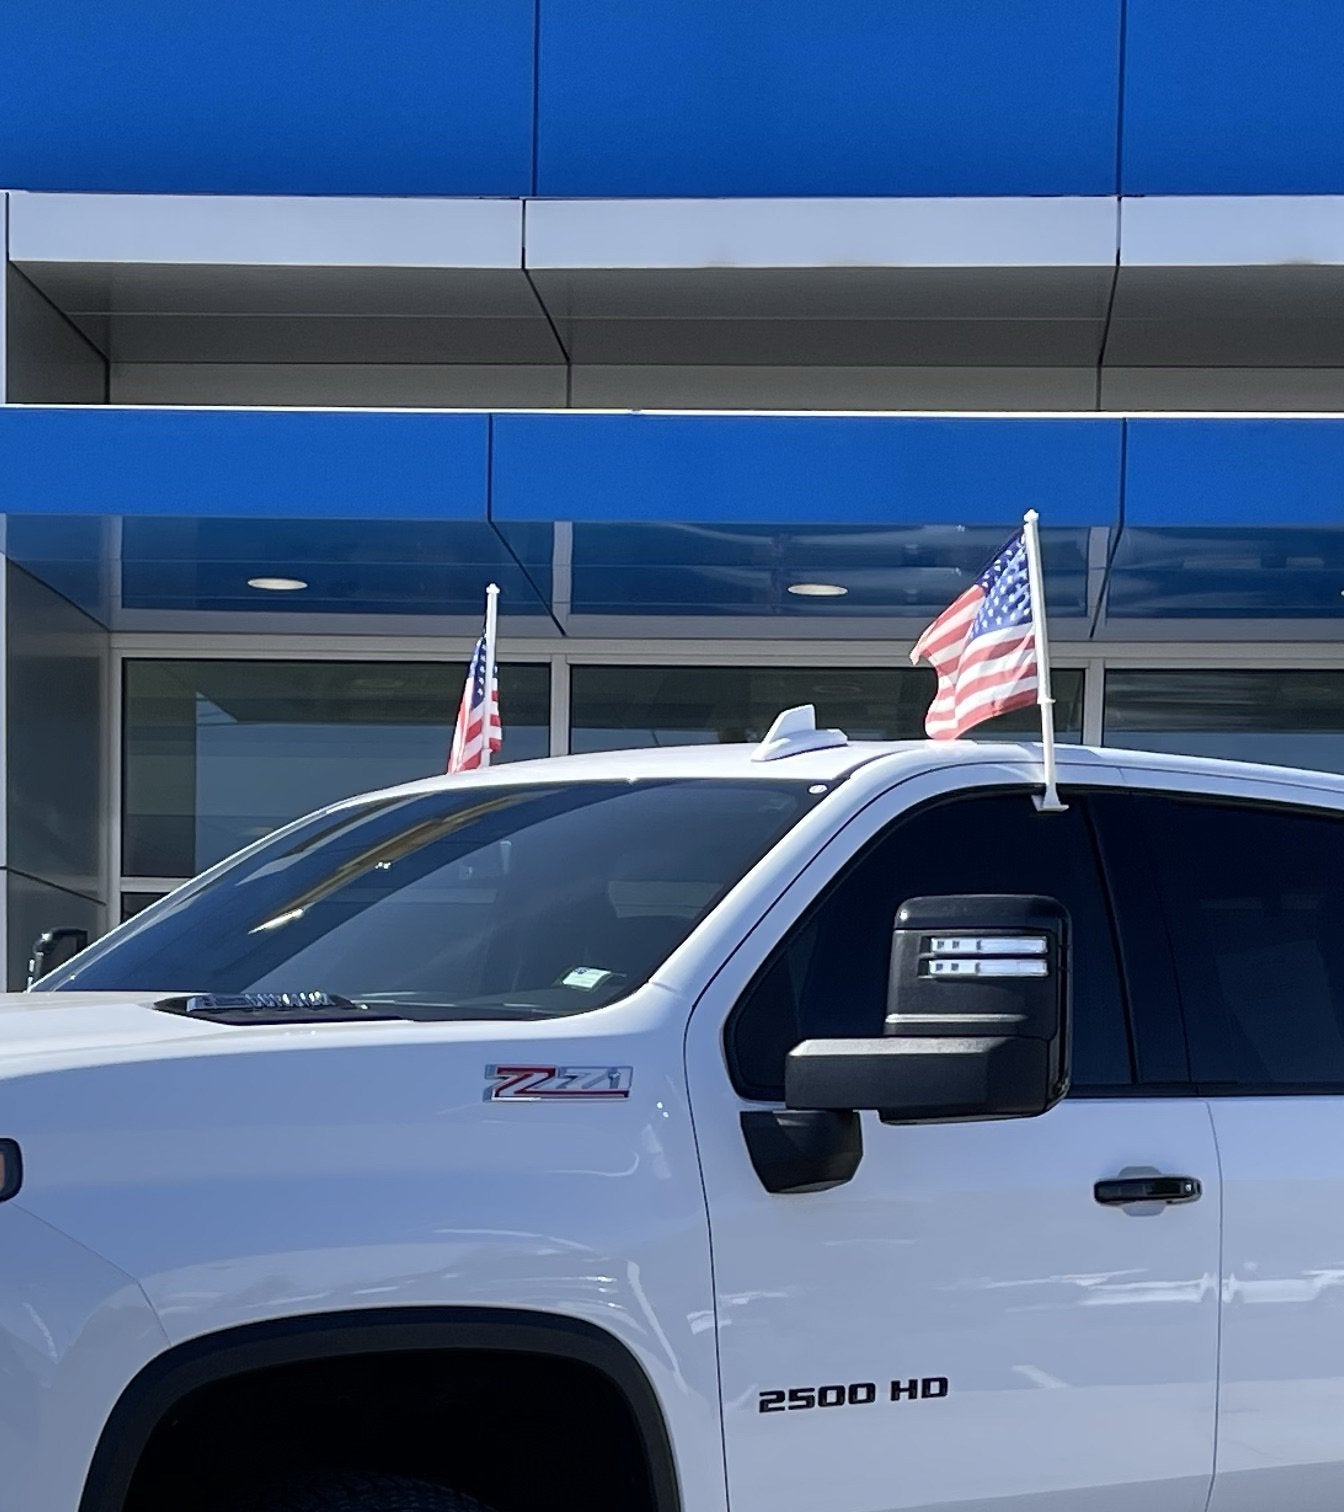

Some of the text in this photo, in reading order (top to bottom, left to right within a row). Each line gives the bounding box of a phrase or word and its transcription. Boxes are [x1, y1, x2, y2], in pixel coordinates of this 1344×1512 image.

[483, 1063, 633, 1103] Z71
[759, 1376, 949, 1413] 2500 HD
